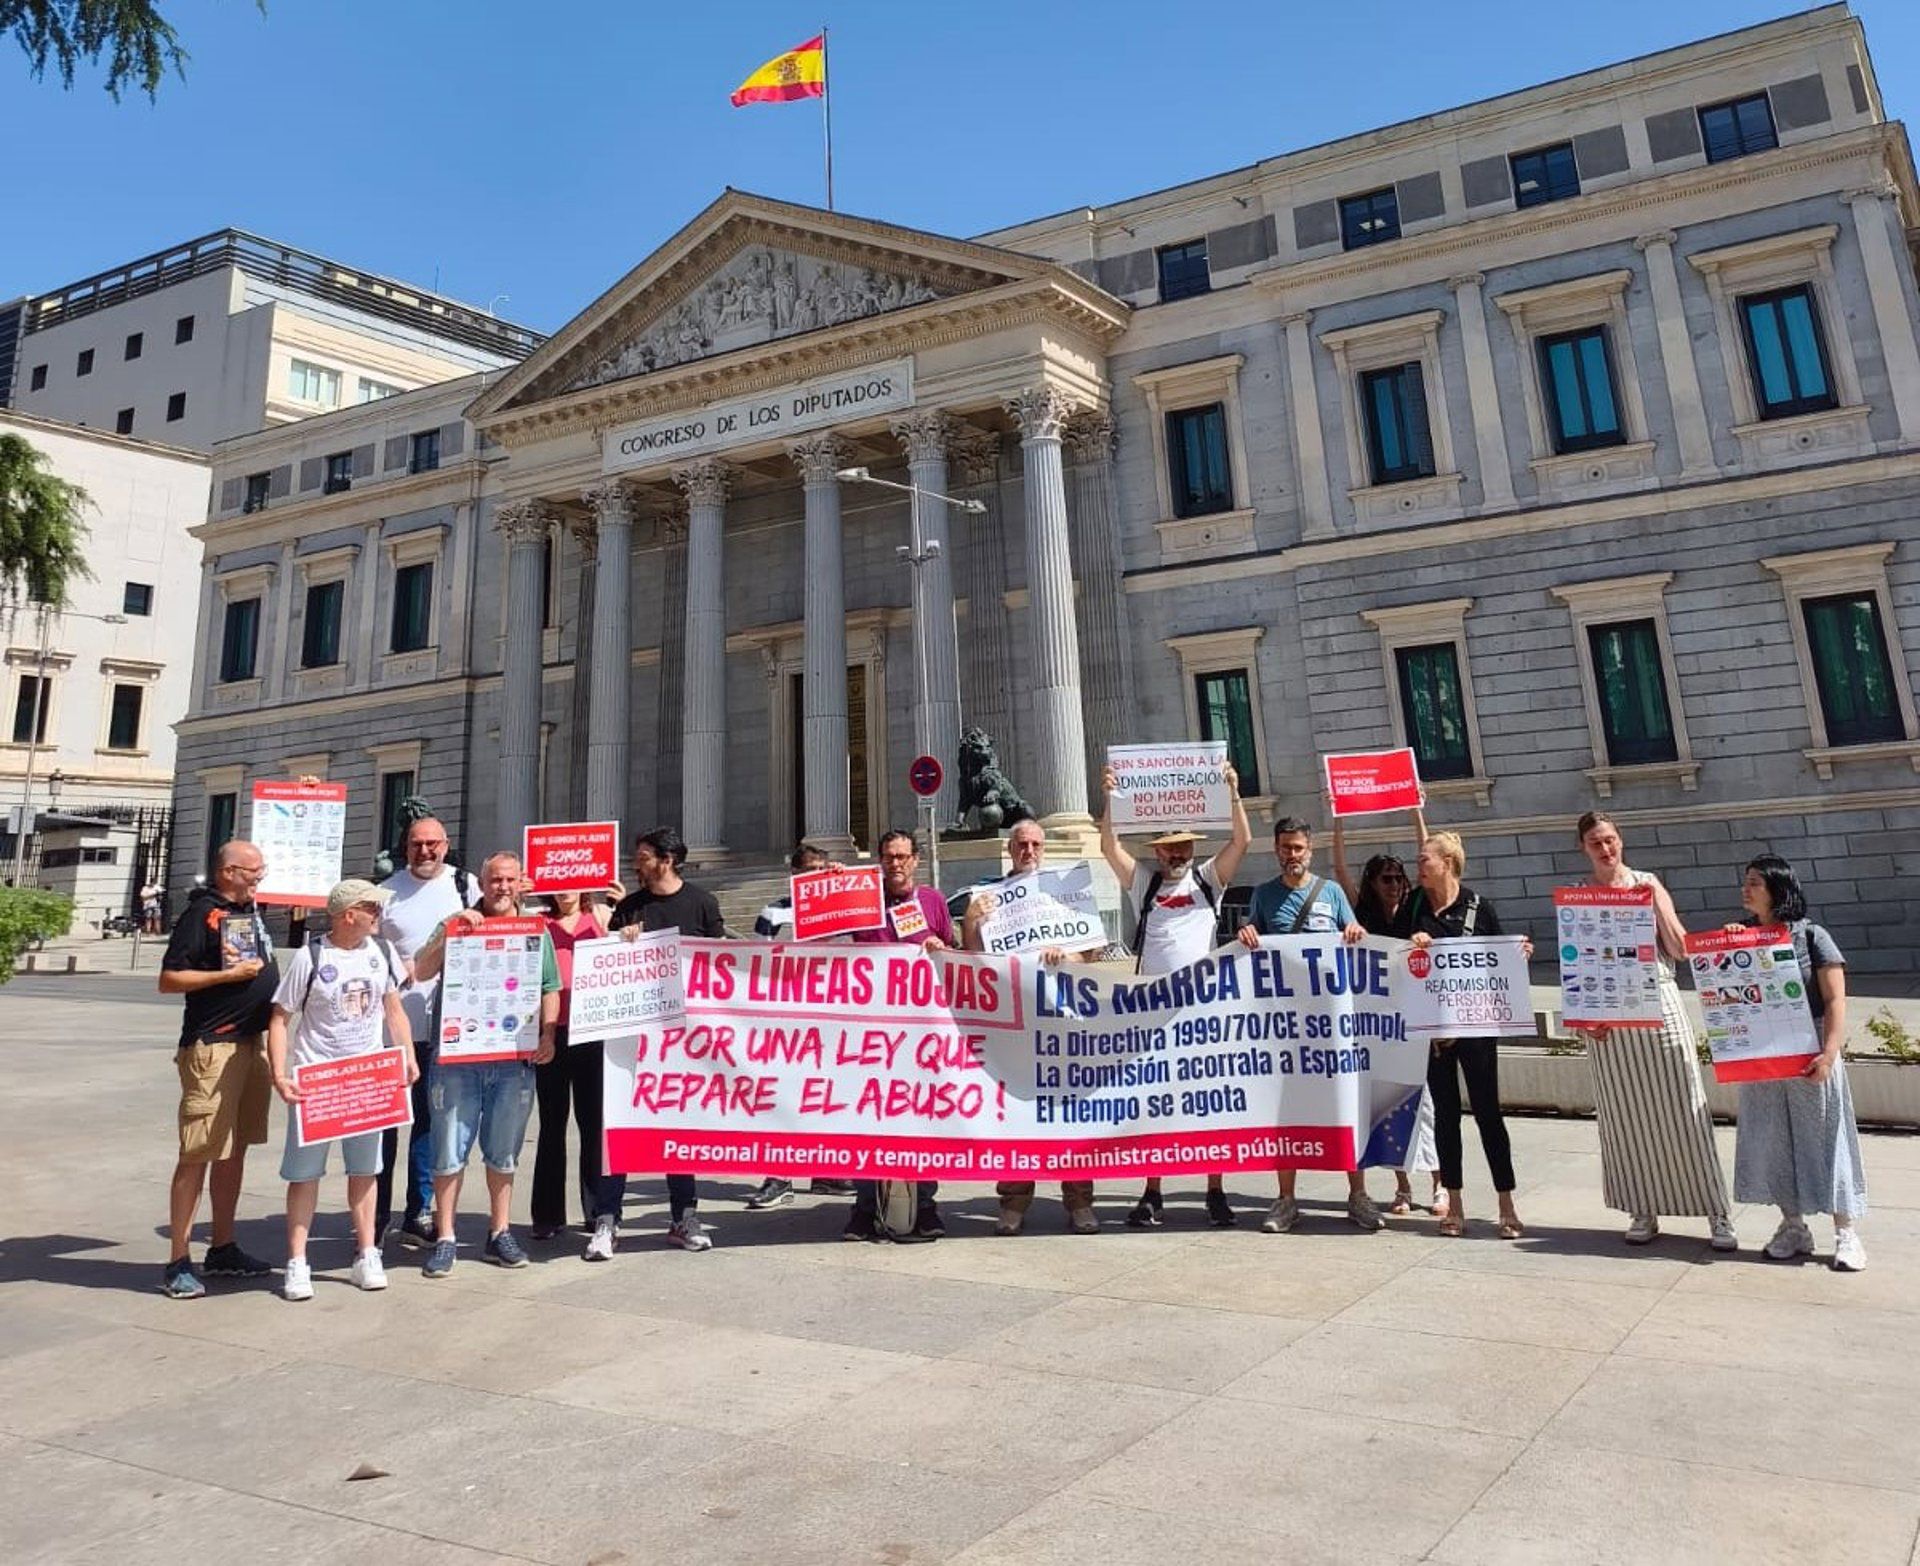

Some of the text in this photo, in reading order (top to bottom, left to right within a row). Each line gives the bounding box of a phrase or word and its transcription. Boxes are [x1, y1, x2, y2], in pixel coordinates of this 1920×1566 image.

[621, 379, 892, 455] CONGRESO DE LOS DIPUTADOS
[1113, 759, 1133, 770] SIN
[1139, 755, 1194, 769] SANCIÓN
[1197, 756, 1207, 766] A
[1134, 787, 1206, 803] NO HABRÁ
[1135, 802, 1206, 817] SOLUCIÓN
[546, 847, 593, 865] SOMOS
[535, 862, 609, 880] PERSONAS
[798, 874, 877, 900] FIJEZA
[996, 885, 1027, 907] ODO
[800, 906, 879, 925] CONSTITUCIONAL
[991, 920, 1090, 952] REPARADO
[593, 945, 677, 969] GOBIERNO
[1434, 952, 1499, 969] CESES
[687, 945, 999, 1012] AS LÍNEAS ROJAS
[1036, 947, 1389, 1018] LAS MARCA EL TJUE
[1437, 992, 1511, 1008] PERSONAL
[1457, 1007, 1513, 1022] CESADO
[1035, 1030, 1060, 1056] La
[1067, 1025, 1166, 1056] Directiva
[1172, 1011, 1300, 1048] 1999/70/CE
[1305, 1014, 1332, 1039] se
[660, 1025, 737, 1067] POR
[747, 1026, 824, 1070] UNA
[836, 1028, 907, 1070] LEY
[915, 1032, 987, 1075] QUE
[302, 1057, 397, 1082] CUMPLAN LA LEY
[1036, 1043, 1370, 1088] La Comisión acorrala a España
[633, 1072, 779, 1117] REPARE
[799, 1077, 848, 1115] EL
[856, 1077, 983, 1121] ABUSO
[1036, 1084, 1247, 1126] El tiempo se agota
[663, 1137, 1324, 1173] Personal interino y temporal de las administraciones públicas
